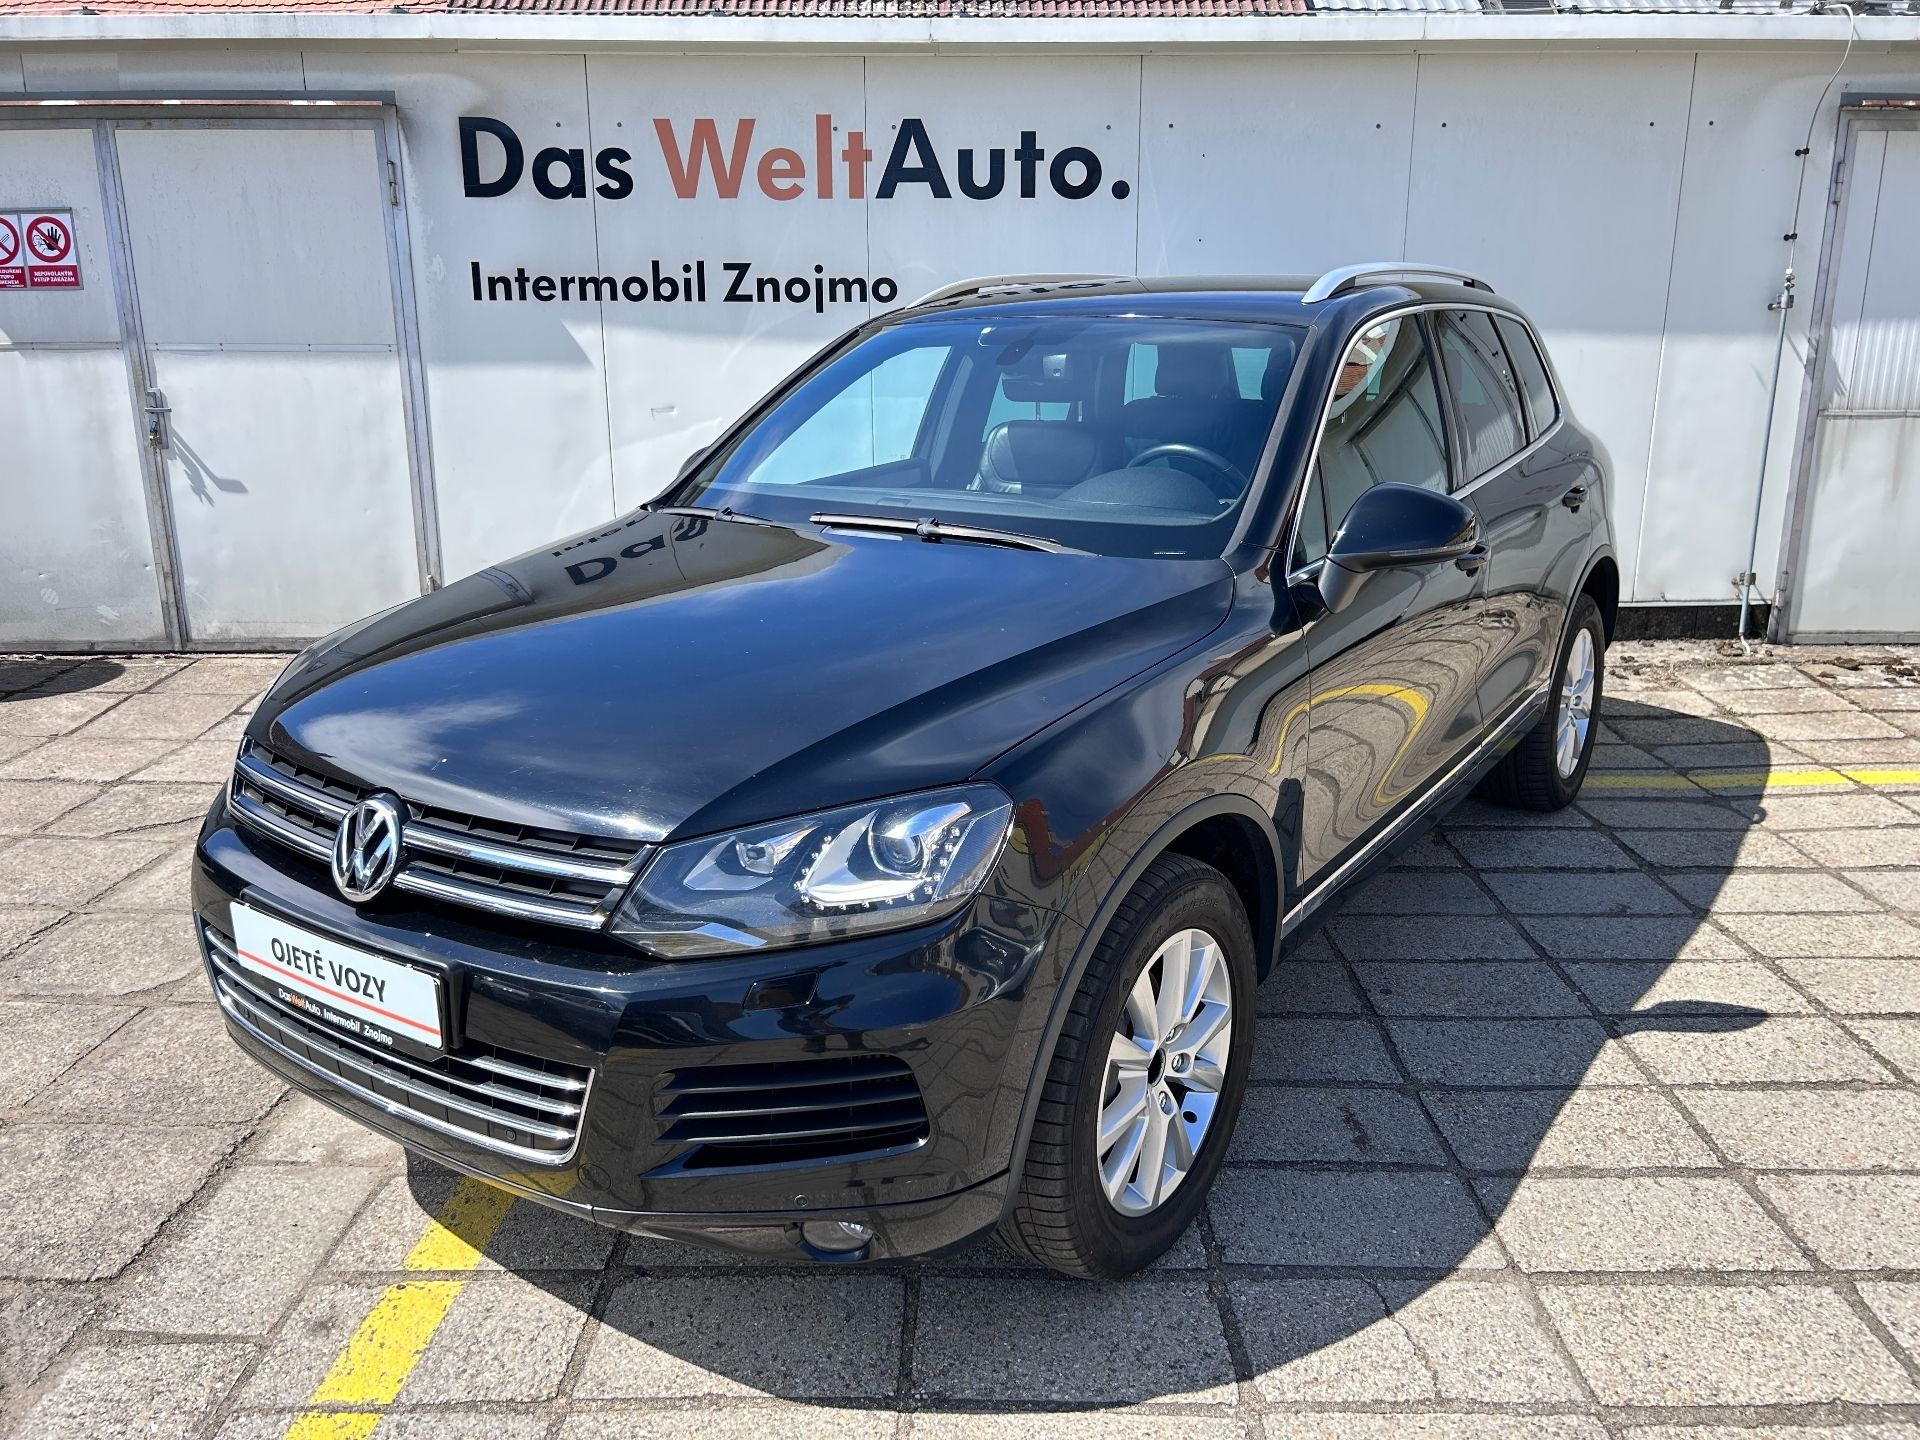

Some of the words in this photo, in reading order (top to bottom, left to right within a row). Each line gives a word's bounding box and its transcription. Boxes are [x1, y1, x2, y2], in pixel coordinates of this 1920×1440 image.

[458, 116, 634, 200] Das
[470, 260, 705, 303] Intermobil
[722, 262, 898, 314] Znojmo
[271, 937, 326, 981] OJETÉ
[329, 959, 386, 1003] VOZY
[323, 1008, 361, 1033] Intermobil
[363, 1025, 393, 1045] Znojmo
